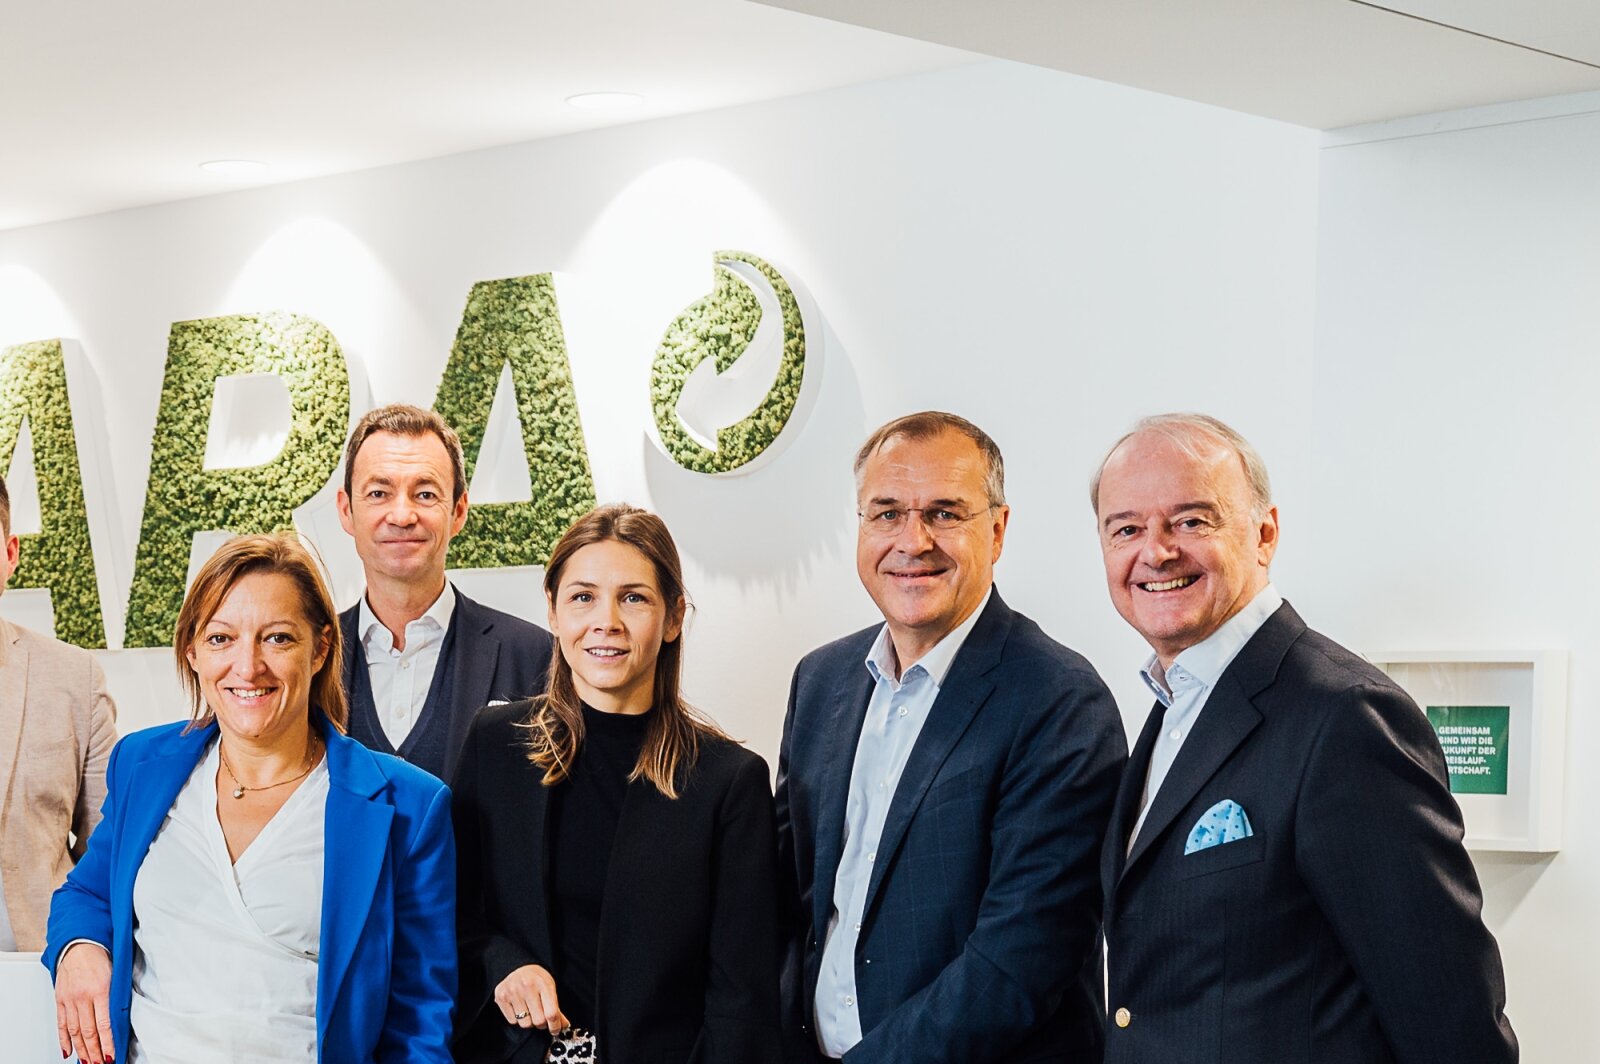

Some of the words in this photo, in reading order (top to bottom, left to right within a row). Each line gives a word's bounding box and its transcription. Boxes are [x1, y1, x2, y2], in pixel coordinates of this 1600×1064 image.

[1439, 726, 1491, 734] GEMEINSAM
[1439, 736, 1459, 744] SIND
[1445, 756, 1486, 764] REISLAUF-
[1448, 766, 1491, 774] RTSCHAFT.
